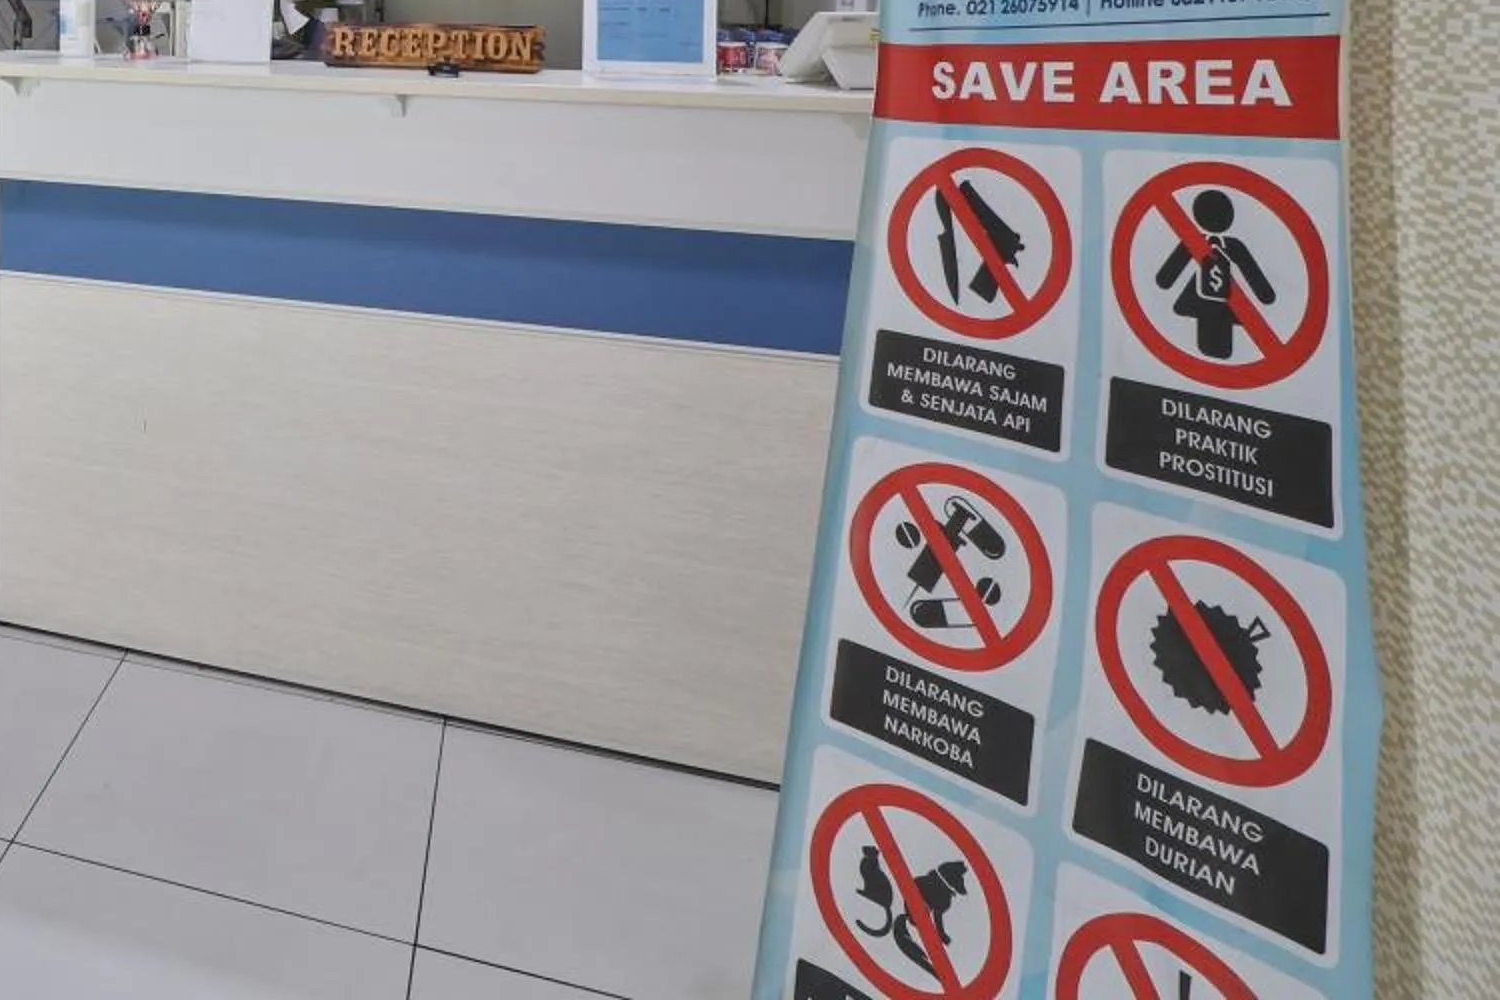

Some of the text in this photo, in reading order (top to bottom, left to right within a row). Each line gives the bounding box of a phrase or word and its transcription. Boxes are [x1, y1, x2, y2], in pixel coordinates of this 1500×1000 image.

[966, 0, 995, 15] 021
[333, 26, 536, 61] RECEPTION
[932, 59, 1293, 107] SAVE AREA
[923, 347, 1016, 380] DILARANG
[887, 363, 1048, 413] MEMBAWA SAJAM
[901, 388, 1031, 433] & SENJATA API
[1161, 398, 1273, 439] DILARANG
[1175, 428, 1259, 465] PRAKTIK
[1159, 451, 1274, 497] PROSTITUSI
[885, 665, 984, 717] DILARANG
[883, 689, 981, 745] MEMBAWA
[884, 715, 974, 768] NARKOBA
[1137, 773, 1264, 843] DILARANG
[1134, 801, 1260, 876] MEMBAWA
[1145, 836, 1236, 895] DURIAN
